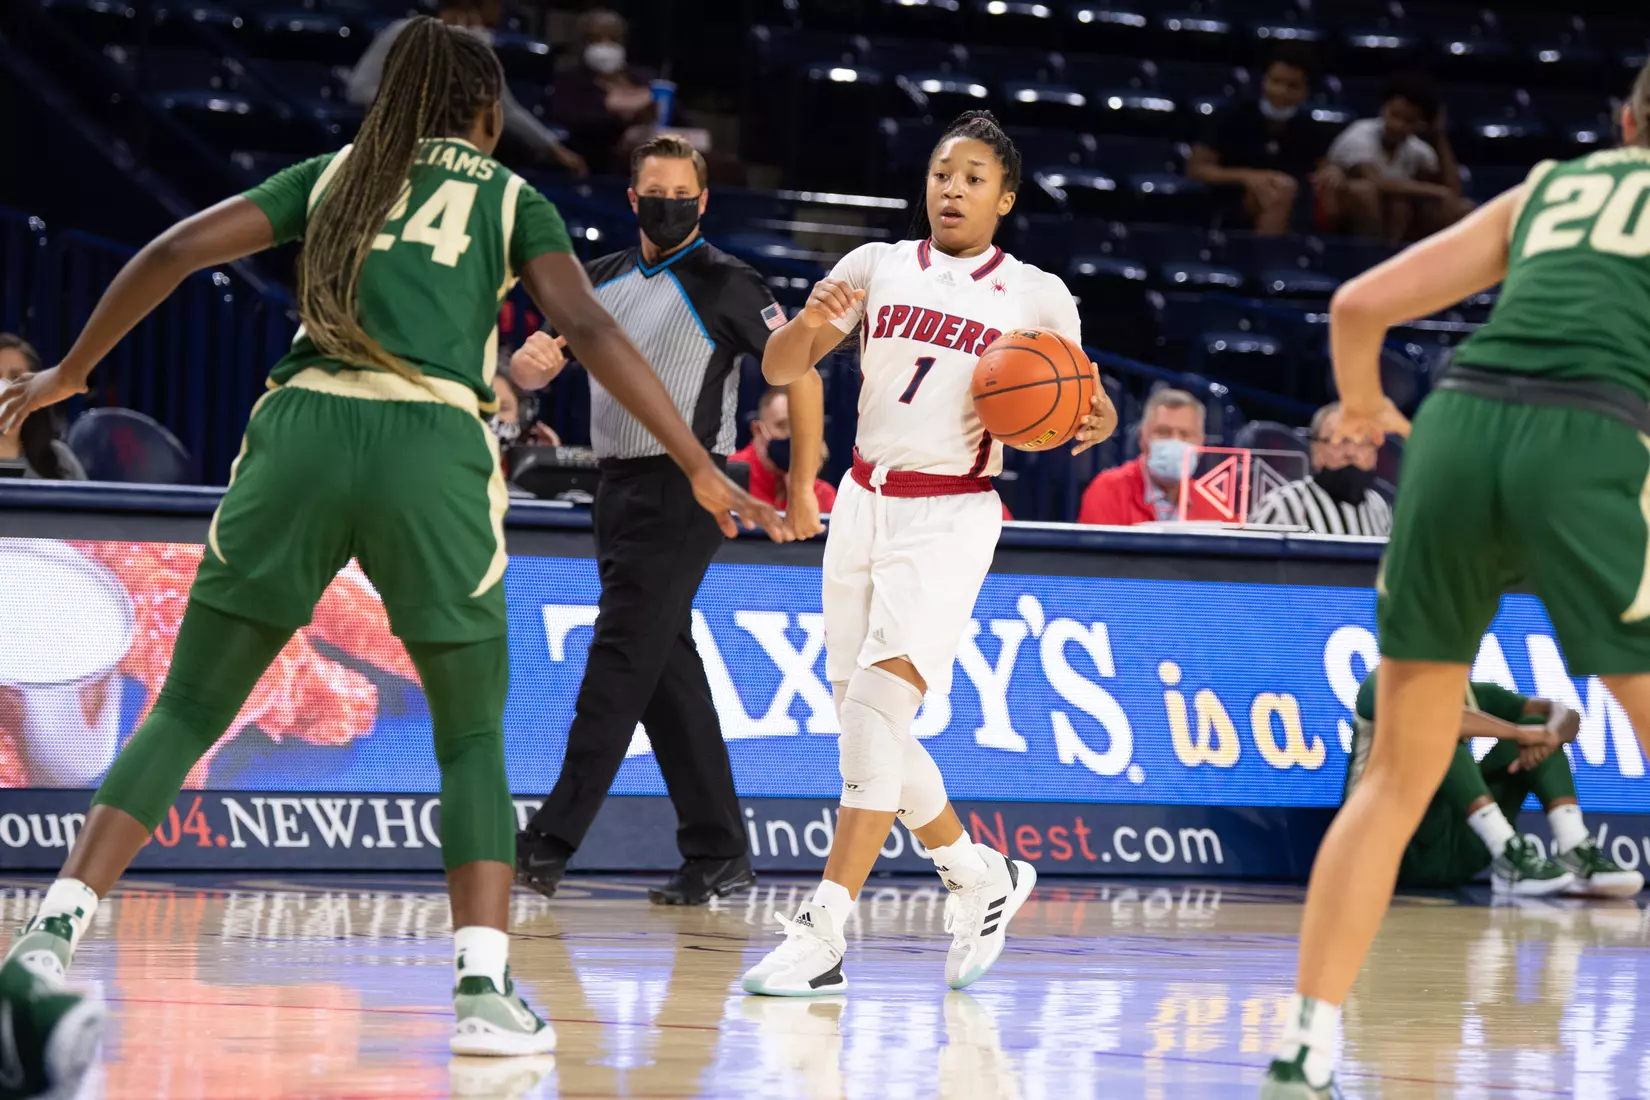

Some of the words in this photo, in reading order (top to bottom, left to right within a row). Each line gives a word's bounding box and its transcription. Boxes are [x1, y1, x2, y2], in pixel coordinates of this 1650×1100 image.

[414, 144, 498, 181] IAMS
[1522, 171, 1650, 258] 20
[872, 304, 1003, 357] SPIDERS
[898, 356, 937, 405] 1
[1158, 661, 1241, 769] is
[1250, 692, 1327, 771] a
